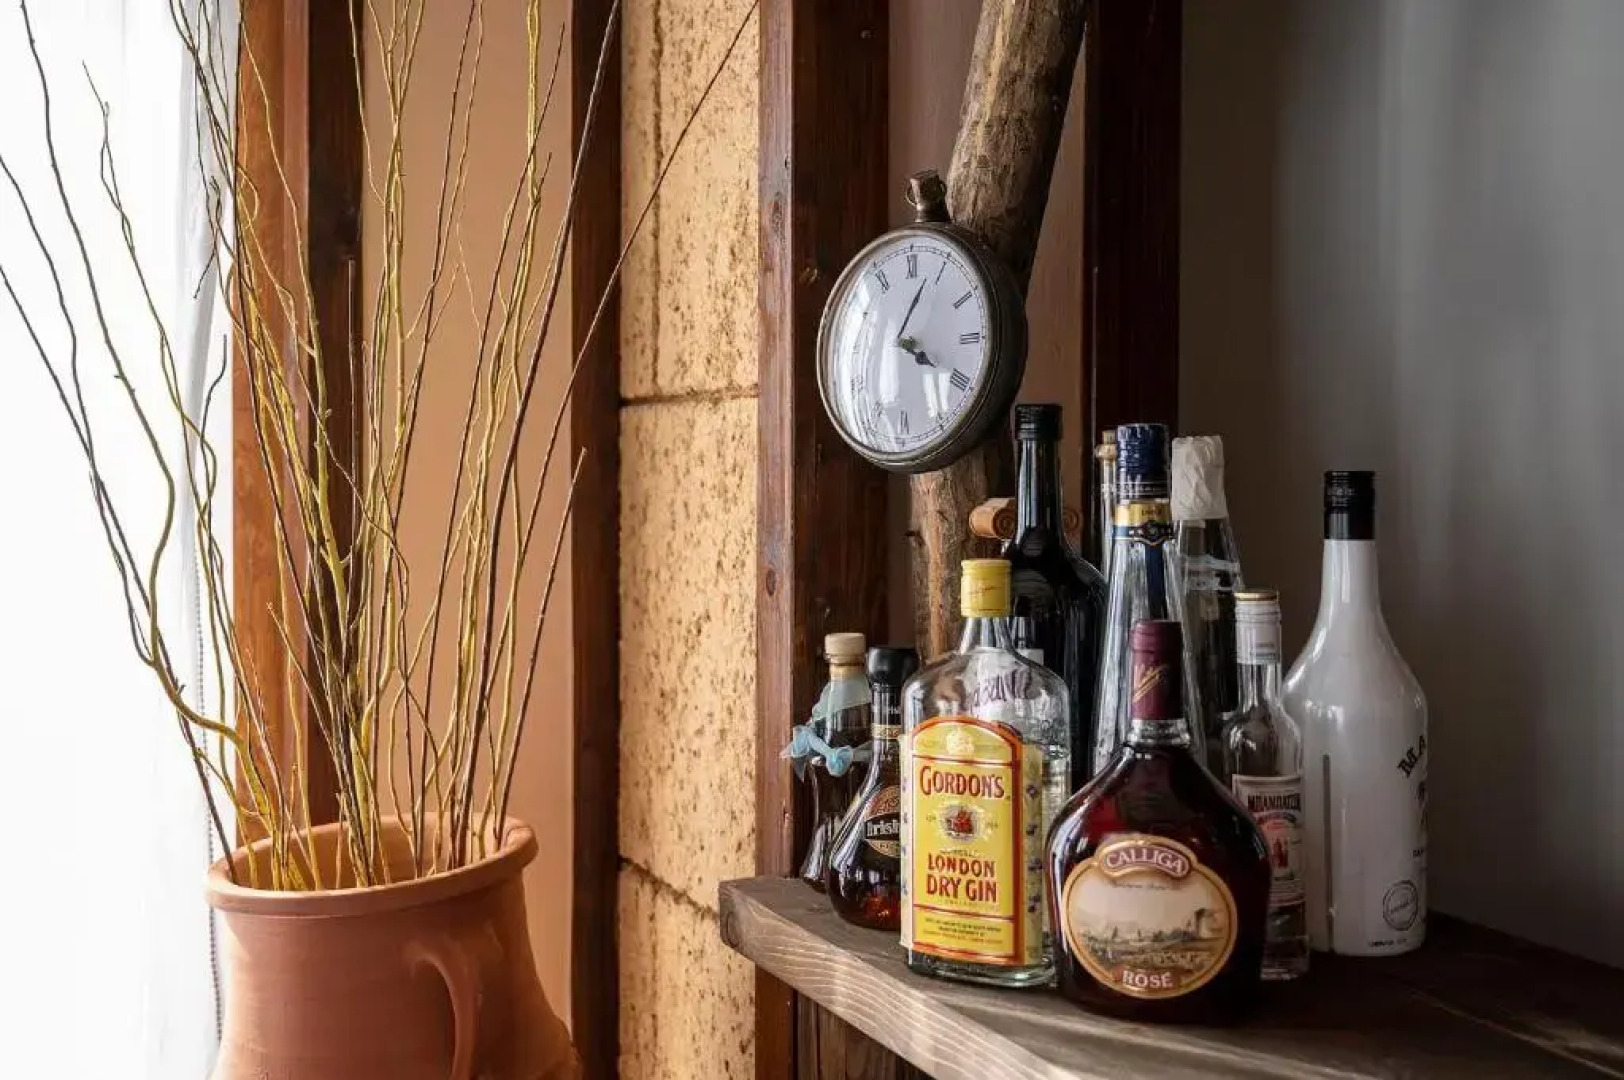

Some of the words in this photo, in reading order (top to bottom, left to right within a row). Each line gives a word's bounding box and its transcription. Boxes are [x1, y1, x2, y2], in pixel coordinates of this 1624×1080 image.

[960, 332, 980, 344] III
[919, 765, 1005, 799] GORDON'S
[866, 818, 900, 838] Irish
[927, 852, 996, 878] LONDON
[1106, 847, 1183, 874] CALLIGA
[926, 873, 961, 899] DRY
[965, 879, 997, 903] GIN
